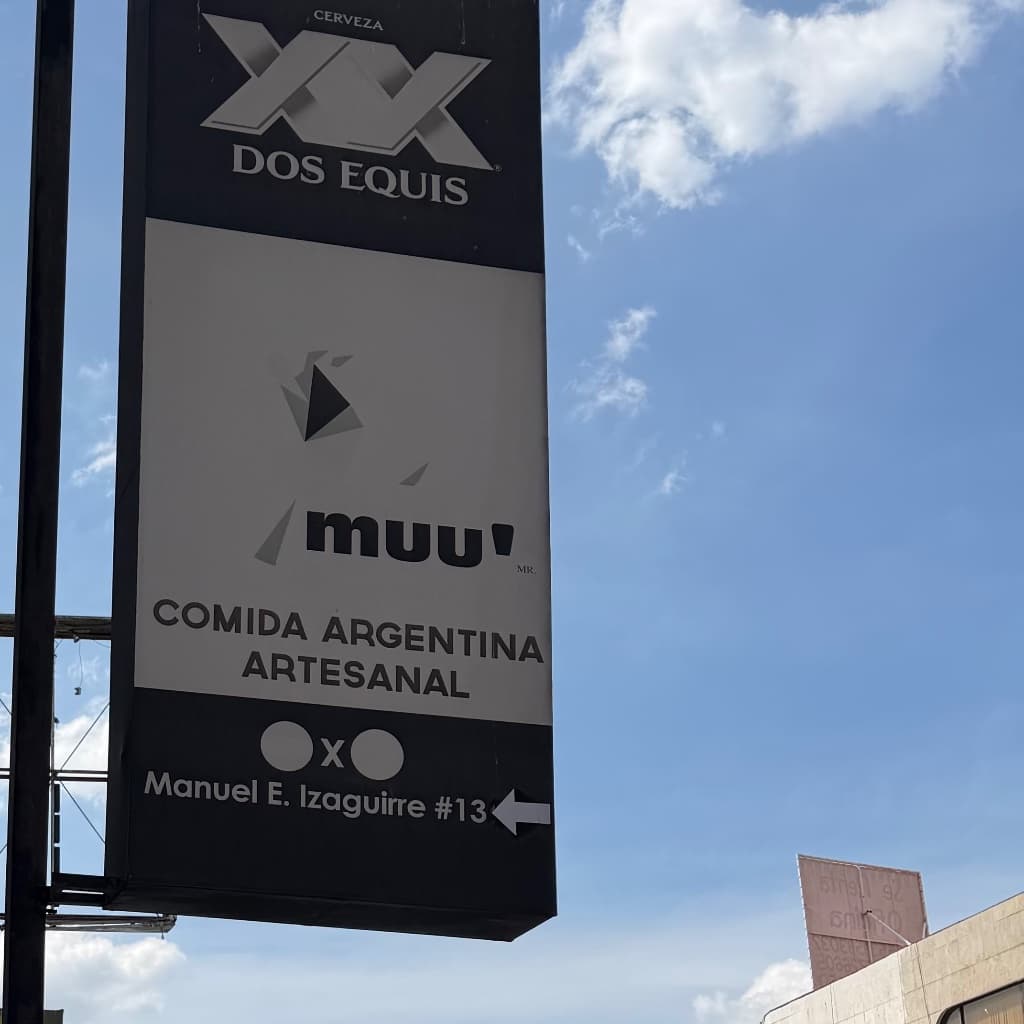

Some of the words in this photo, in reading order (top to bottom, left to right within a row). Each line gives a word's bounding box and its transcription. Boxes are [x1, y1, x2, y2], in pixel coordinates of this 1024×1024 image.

[314, 9, 384, 31] CERVEZA
[232, 144, 325, 185] DOS
[340, 161, 469, 206] EQUIS
[153, 598, 308, 641] COMIDA
[321, 615, 545, 663] ARGENTINA
[241, 651, 470, 698] ARTESANAL
[143, 769, 258, 805] Manuel
[267, 784, 290, 807] E.
[300, 784, 426, 819] Izaguirre
[435, 797, 487, 824] #13
